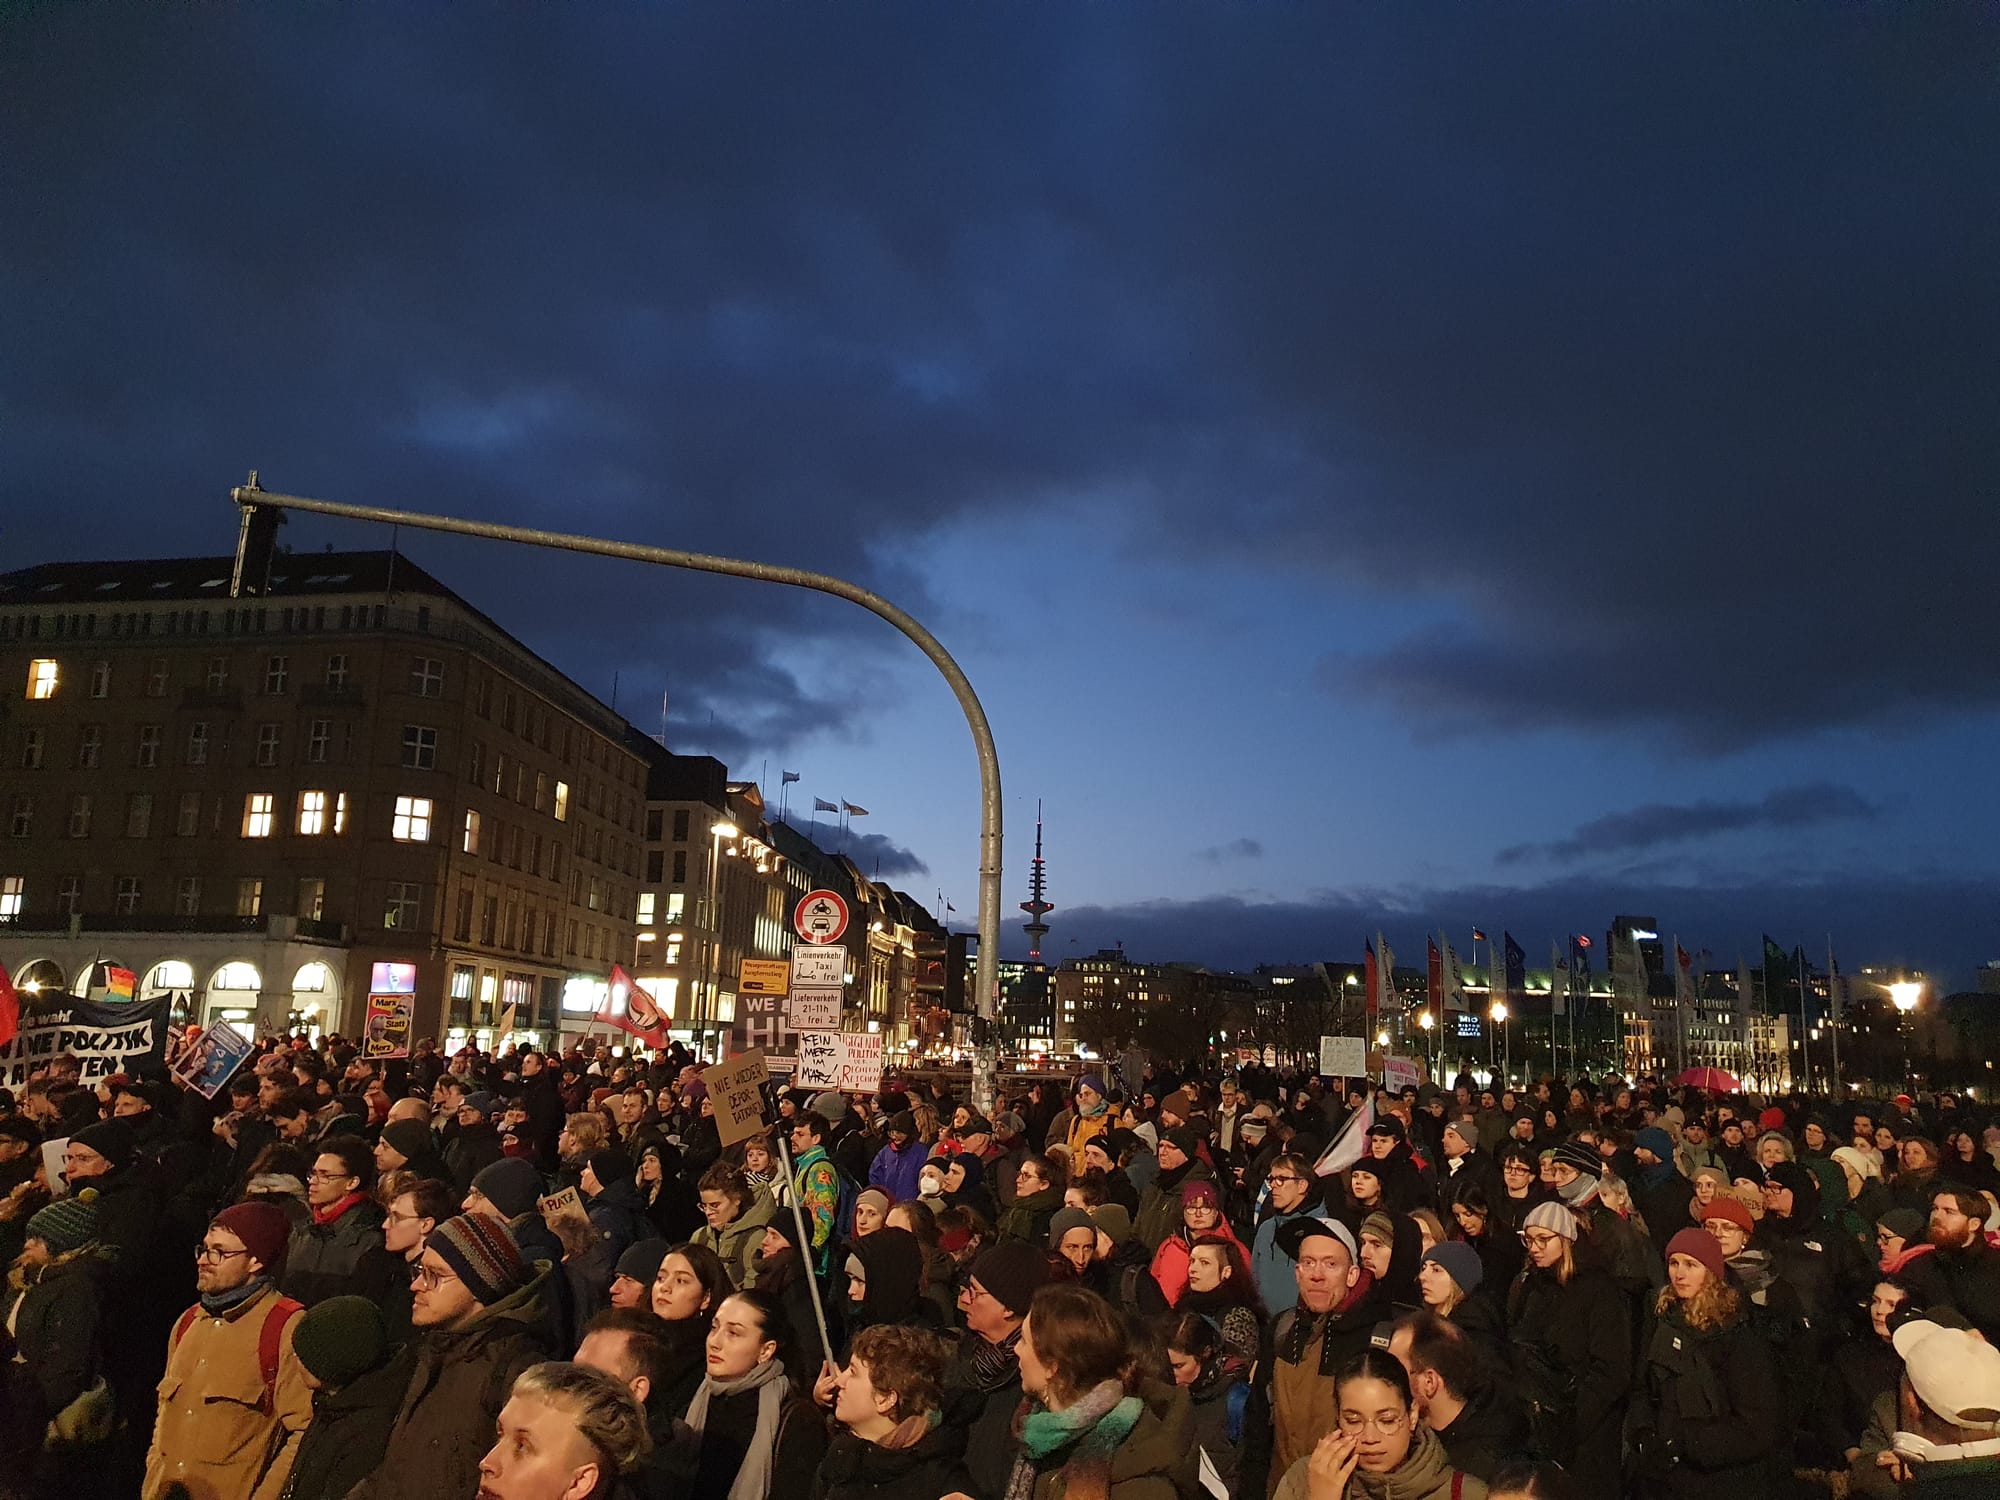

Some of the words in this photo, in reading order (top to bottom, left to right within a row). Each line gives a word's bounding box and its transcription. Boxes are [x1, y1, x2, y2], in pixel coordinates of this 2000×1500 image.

[796, 950, 842, 960] Linienverkehr
[815, 961, 833, 970] Taxi
[823, 972, 839, 981] frei
[794, 993, 838, 1002] Lieferverkehr
[375, 998, 397, 1007] Marx
[745, 997, 776, 1012] WE
[802, 1004, 829, 1013] 21-11h
[808, 1016, 823, 1024] frei
[58, 1026, 150, 1052] POLITIK
[801, 1032, 831, 1046] KEIN
[804, 1047, 836, 1058] MERZ
[813, 1058, 825, 1067] IM
[713, 1076, 731, 1095] NIE
[545, 1191, 575, 1211] PLATZ
